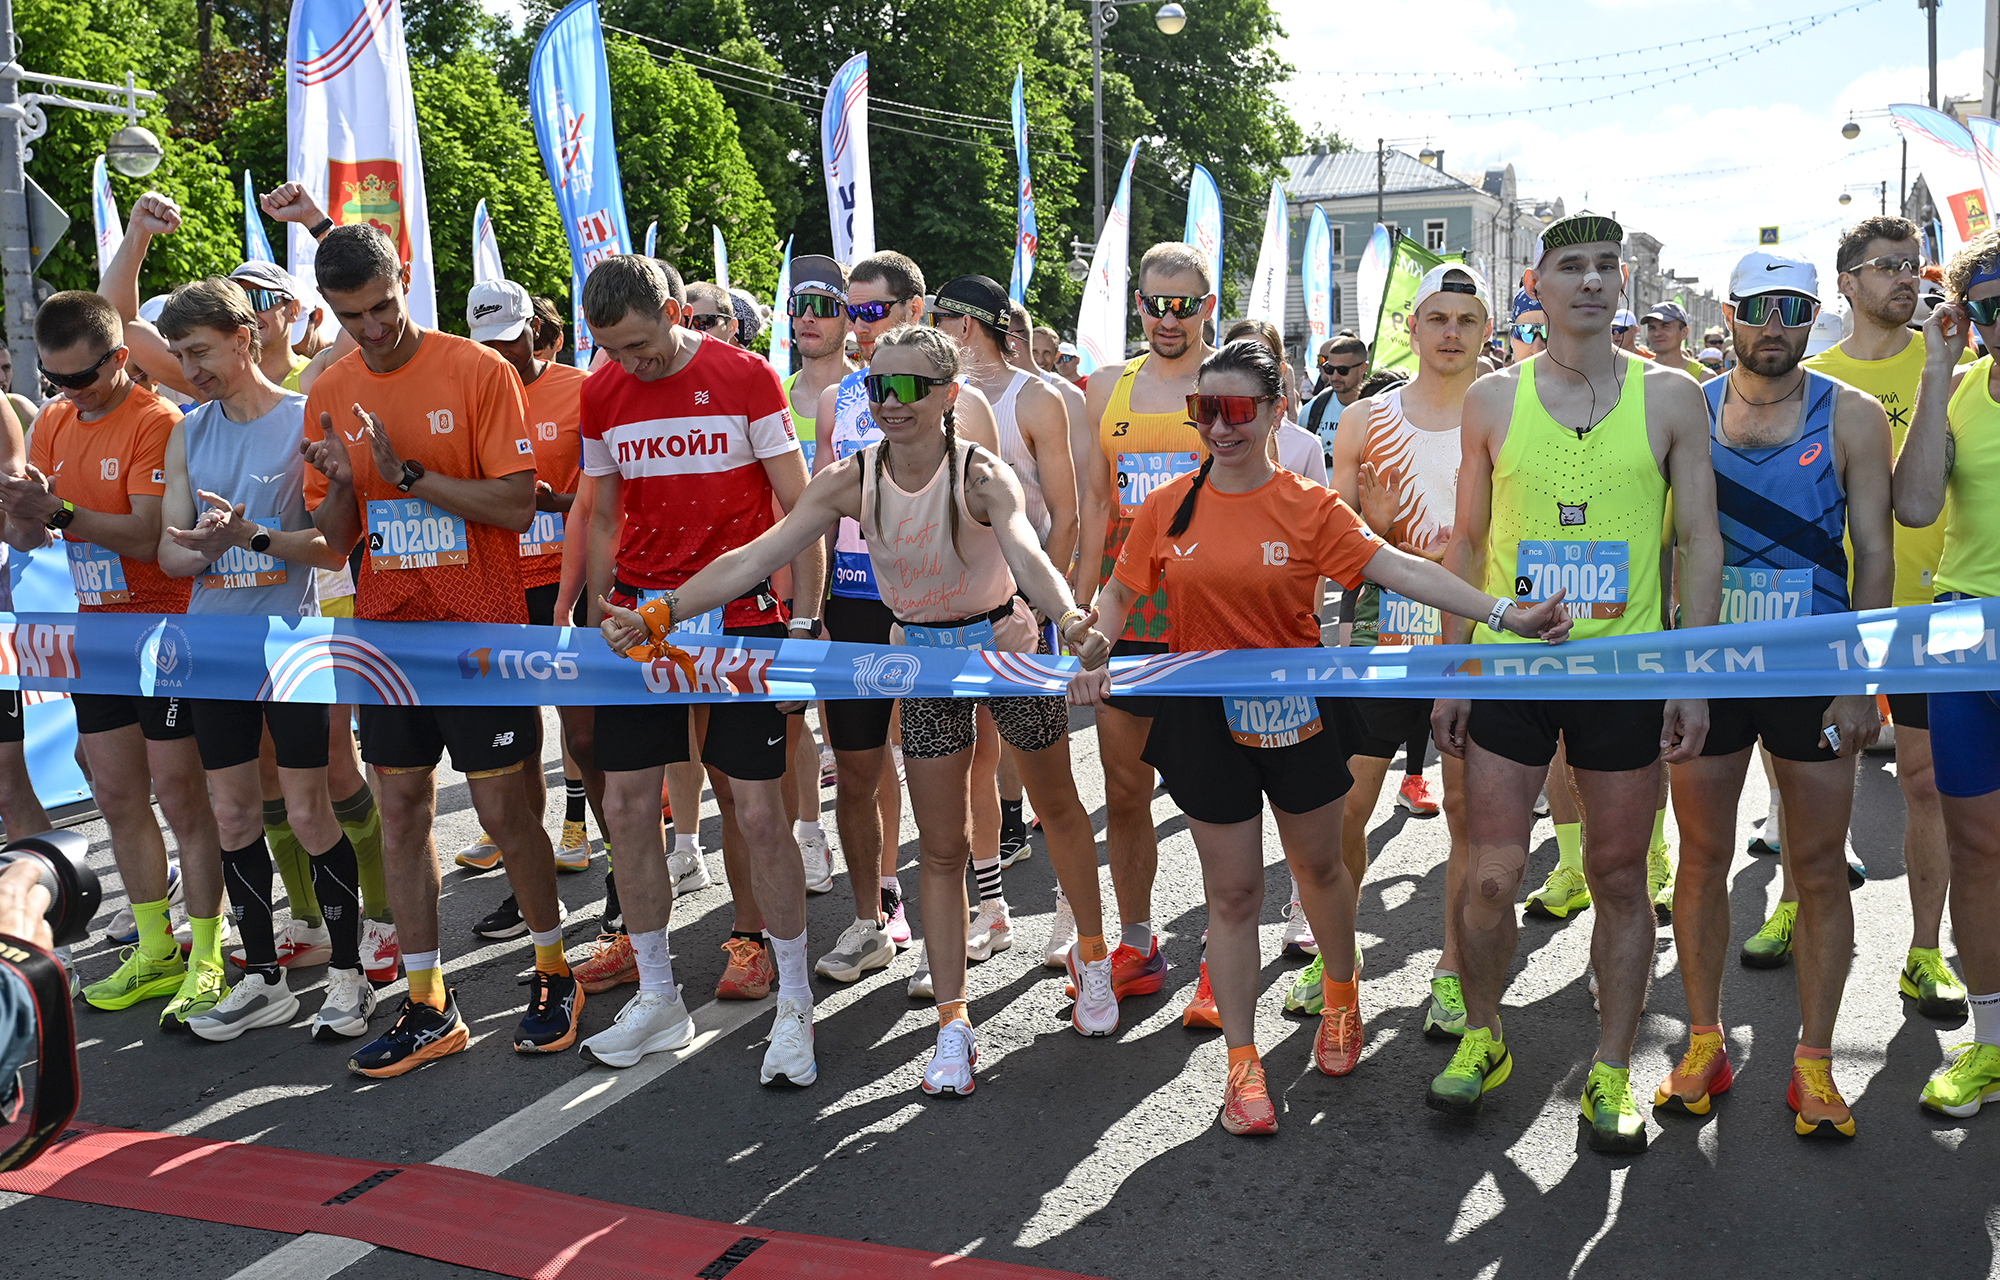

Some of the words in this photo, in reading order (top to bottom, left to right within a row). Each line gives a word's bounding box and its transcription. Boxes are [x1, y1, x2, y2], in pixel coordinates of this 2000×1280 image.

[617, 428, 729, 465] ЛУКОЙЛ
[1127, 472, 1185, 504] 701
[377, 516, 456, 554] 70208
[893, 517, 939, 553] Fast
[836, 567, 867, 584] grom
[893, 551, 944, 589] Bold
[1528, 563, 1616, 601] 70002
[890, 570, 970, 614] Beautiful
[1718, 587, 1800, 624] 70007
[1386, 601, 1442, 634] 7029
[0, 622, 77, 679] ТАРТ
[498, 649, 580, 680] ПСБ
[1828, 637, 1890, 671] 10
[1233, 695, 1312, 733] 70229
